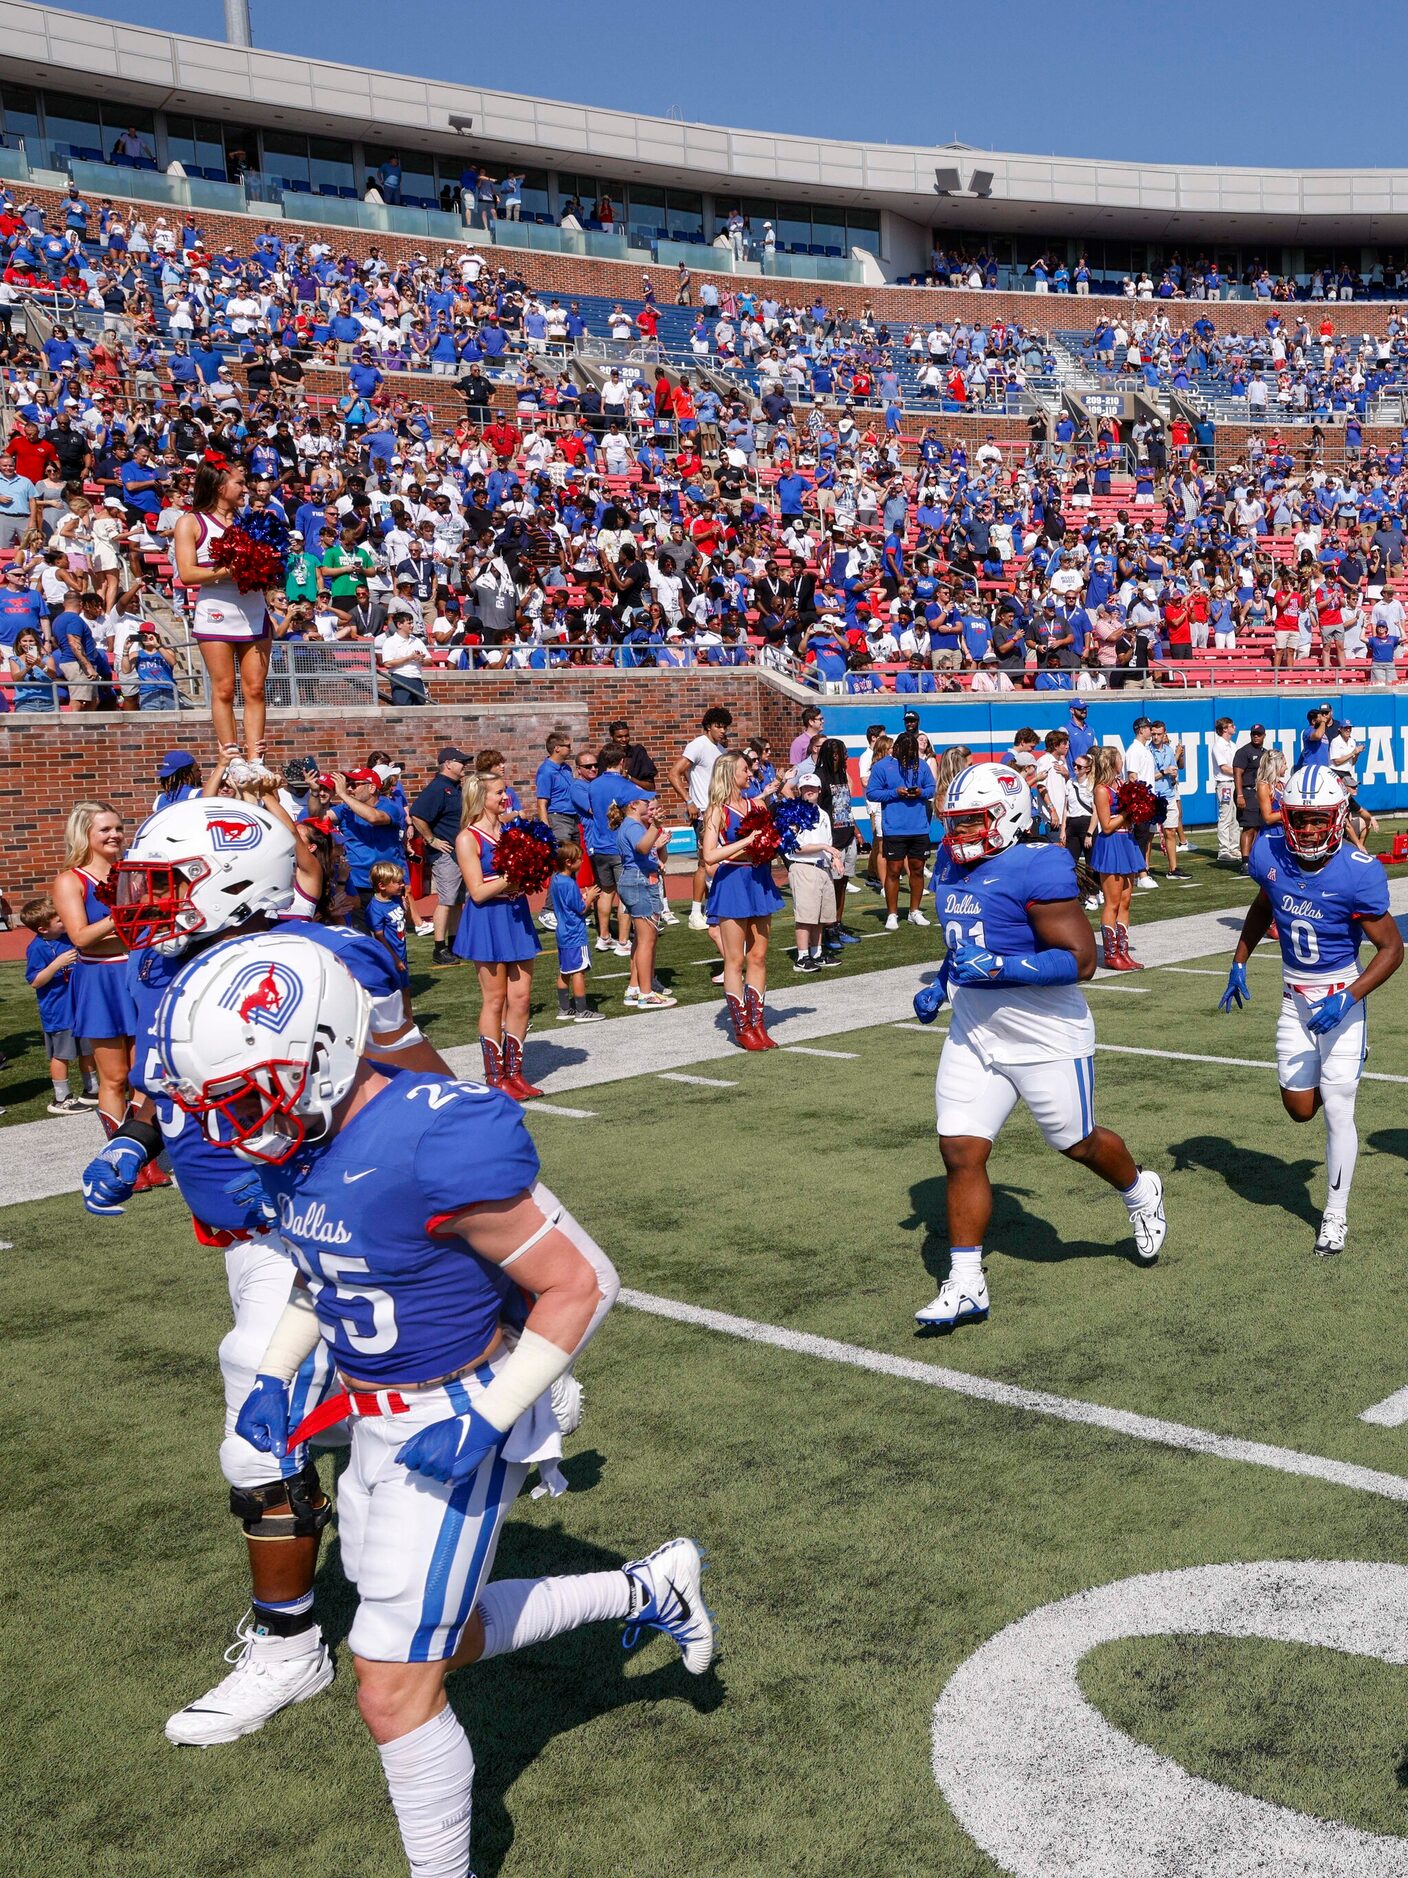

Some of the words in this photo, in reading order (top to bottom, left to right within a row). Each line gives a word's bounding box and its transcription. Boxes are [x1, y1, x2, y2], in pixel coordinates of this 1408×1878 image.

[1085, 396, 1119, 406] 209-210
[970, 621, 987, 631] SMU
[944, 893, 982, 915] Dallas
[1281, 895, 1324, 919] Dallas
[1290, 918, 1320, 965] 0
[405, 1080, 491, 1111] 25
[278, 1192, 353, 1245] Dallas
